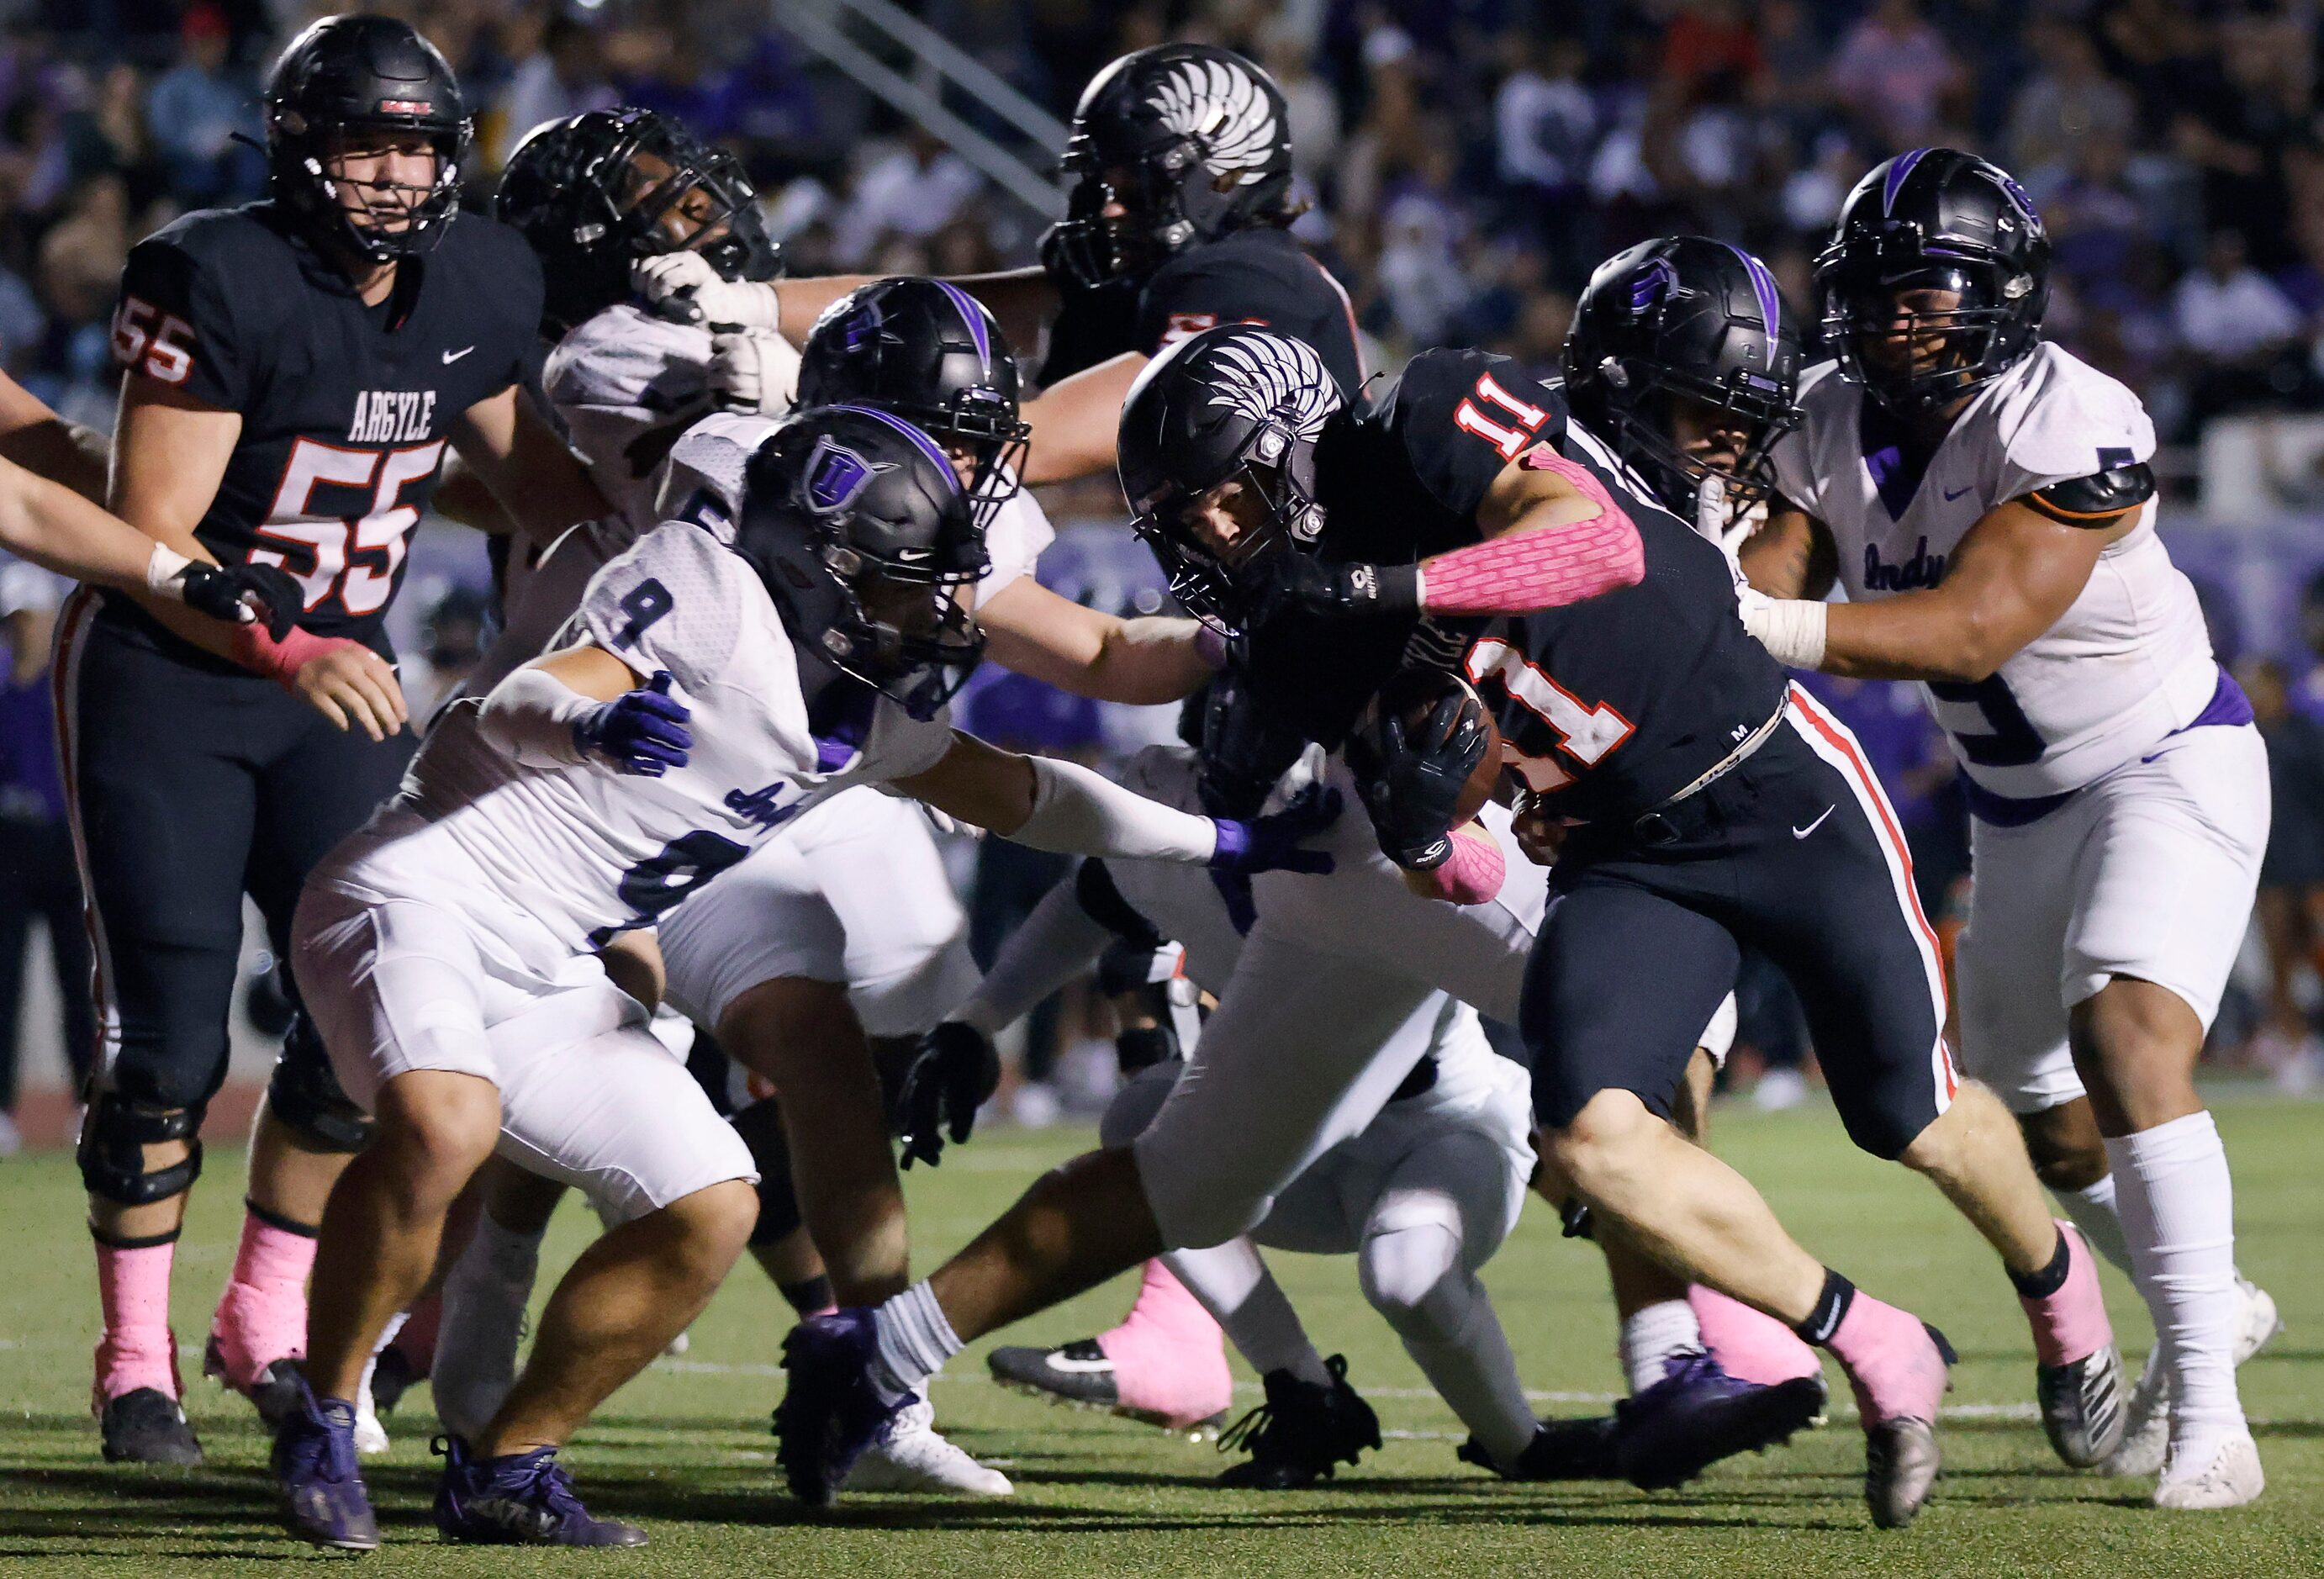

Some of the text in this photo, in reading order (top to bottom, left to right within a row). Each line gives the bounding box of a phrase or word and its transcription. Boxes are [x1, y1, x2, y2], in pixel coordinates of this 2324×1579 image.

[110, 295, 197, 387] 55
[347, 390, 436, 442] ARGYLE
[1453, 371, 1551, 463] 11
[246, 436, 447, 616] 55
[611, 578, 673, 653] 9
[1730, 724, 1749, 742] M
